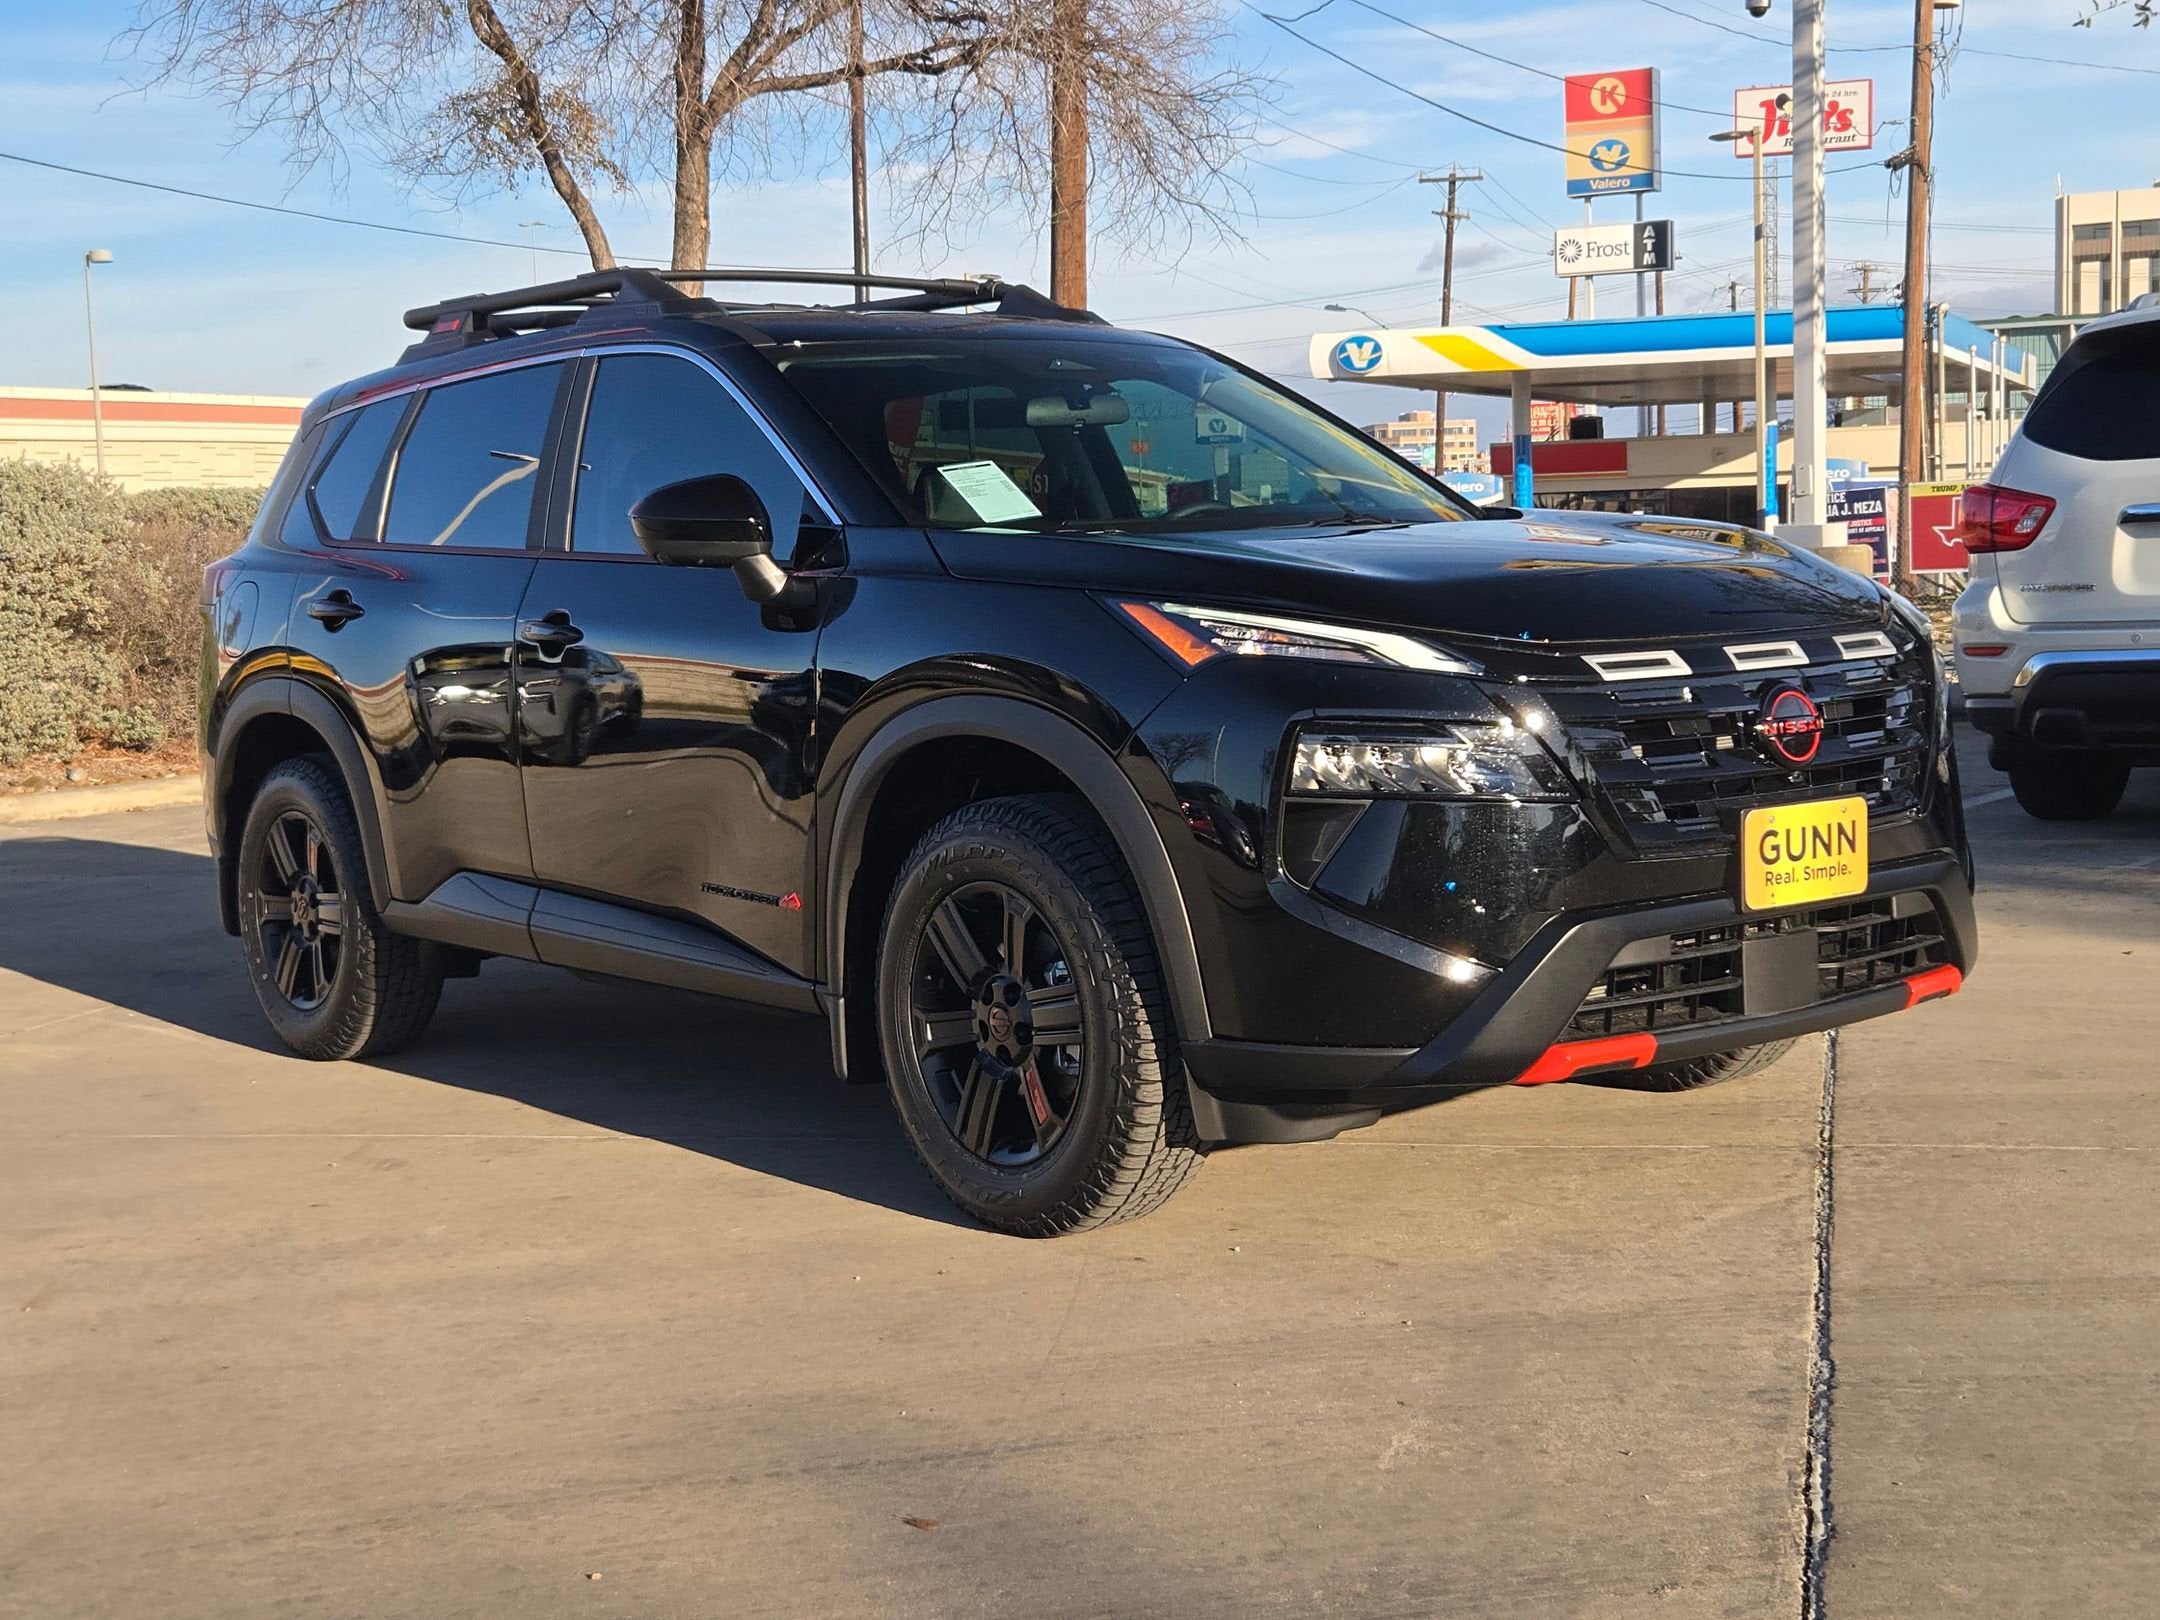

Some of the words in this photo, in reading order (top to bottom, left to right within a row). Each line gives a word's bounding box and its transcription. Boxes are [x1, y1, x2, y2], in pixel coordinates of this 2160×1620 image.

[1589, 178, 1630, 190] Valero
[1586, 240, 1630, 258] Frost
[1643, 225, 1656, 265] ATM
[1826, 469, 1850, 478] ero
[1033, 474, 1049, 494] ST
[1447, 482, 1484, 492] alero
[1826, 492, 1846, 503] TICE
[1841, 503, 1852, 515] J.
[1854, 500, 1883, 514] MEZA
[1762, 718, 1825, 735] NISSAN
[1759, 820, 1856, 865] GUNN
[1765, 867, 1799, 886] Real.
[1803, 861, 1852, 881] Simple.
